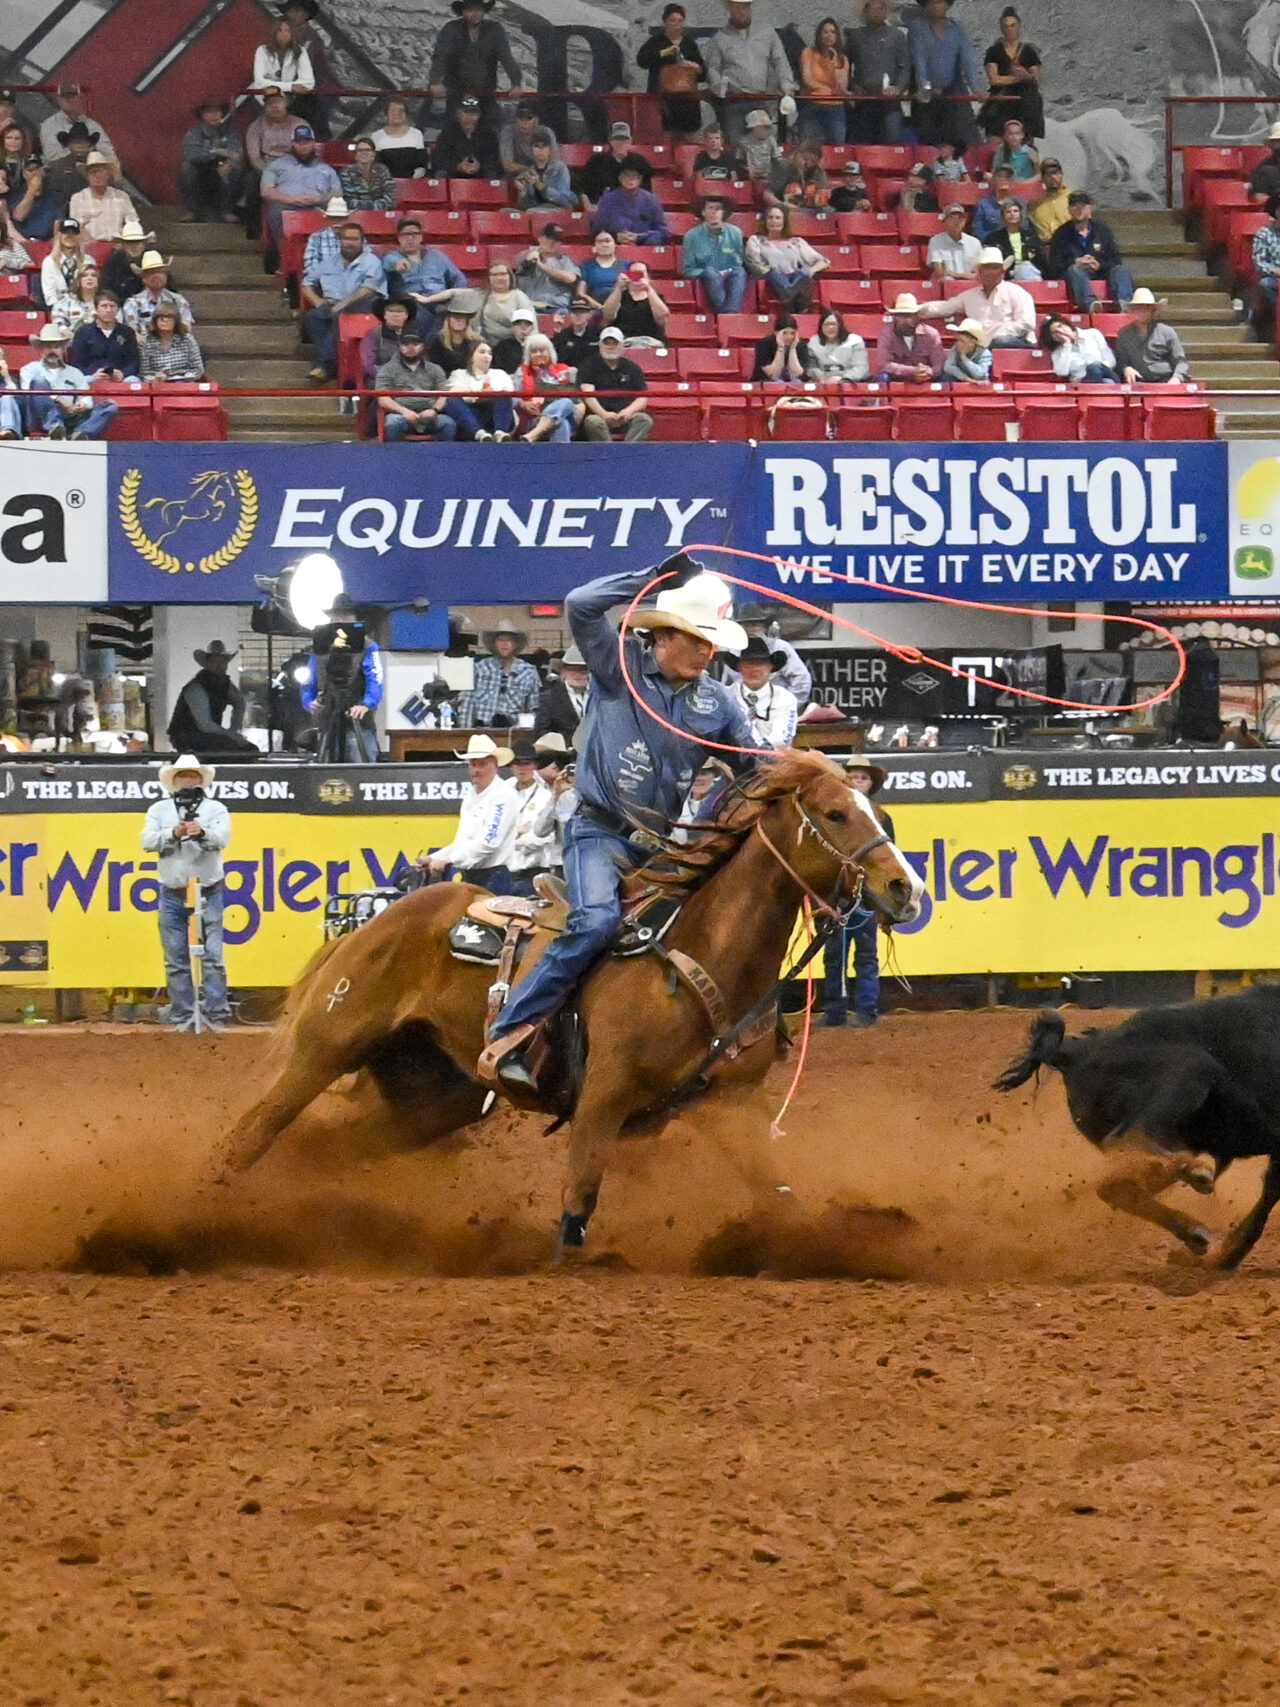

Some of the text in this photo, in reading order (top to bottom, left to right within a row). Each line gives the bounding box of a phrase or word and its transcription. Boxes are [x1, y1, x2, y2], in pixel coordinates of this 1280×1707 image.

[764, 457, 1197, 546] RESISTOL
[272, 486, 714, 556] EQUINETY
[773, 553, 1191, 584] WE LIVE IT EVERY DAY
[930, 770, 973, 789] ON.
[1044, 768, 1092, 786] THE
[1097, 766, 1191, 785] LEGACY
[1196, 764, 1267, 784] LIVES
[22, 781, 73, 799] THE
[253, 781, 295, 800] ON.
[360, 783, 408, 800] THE
[47, 847, 350, 945] Wragler
